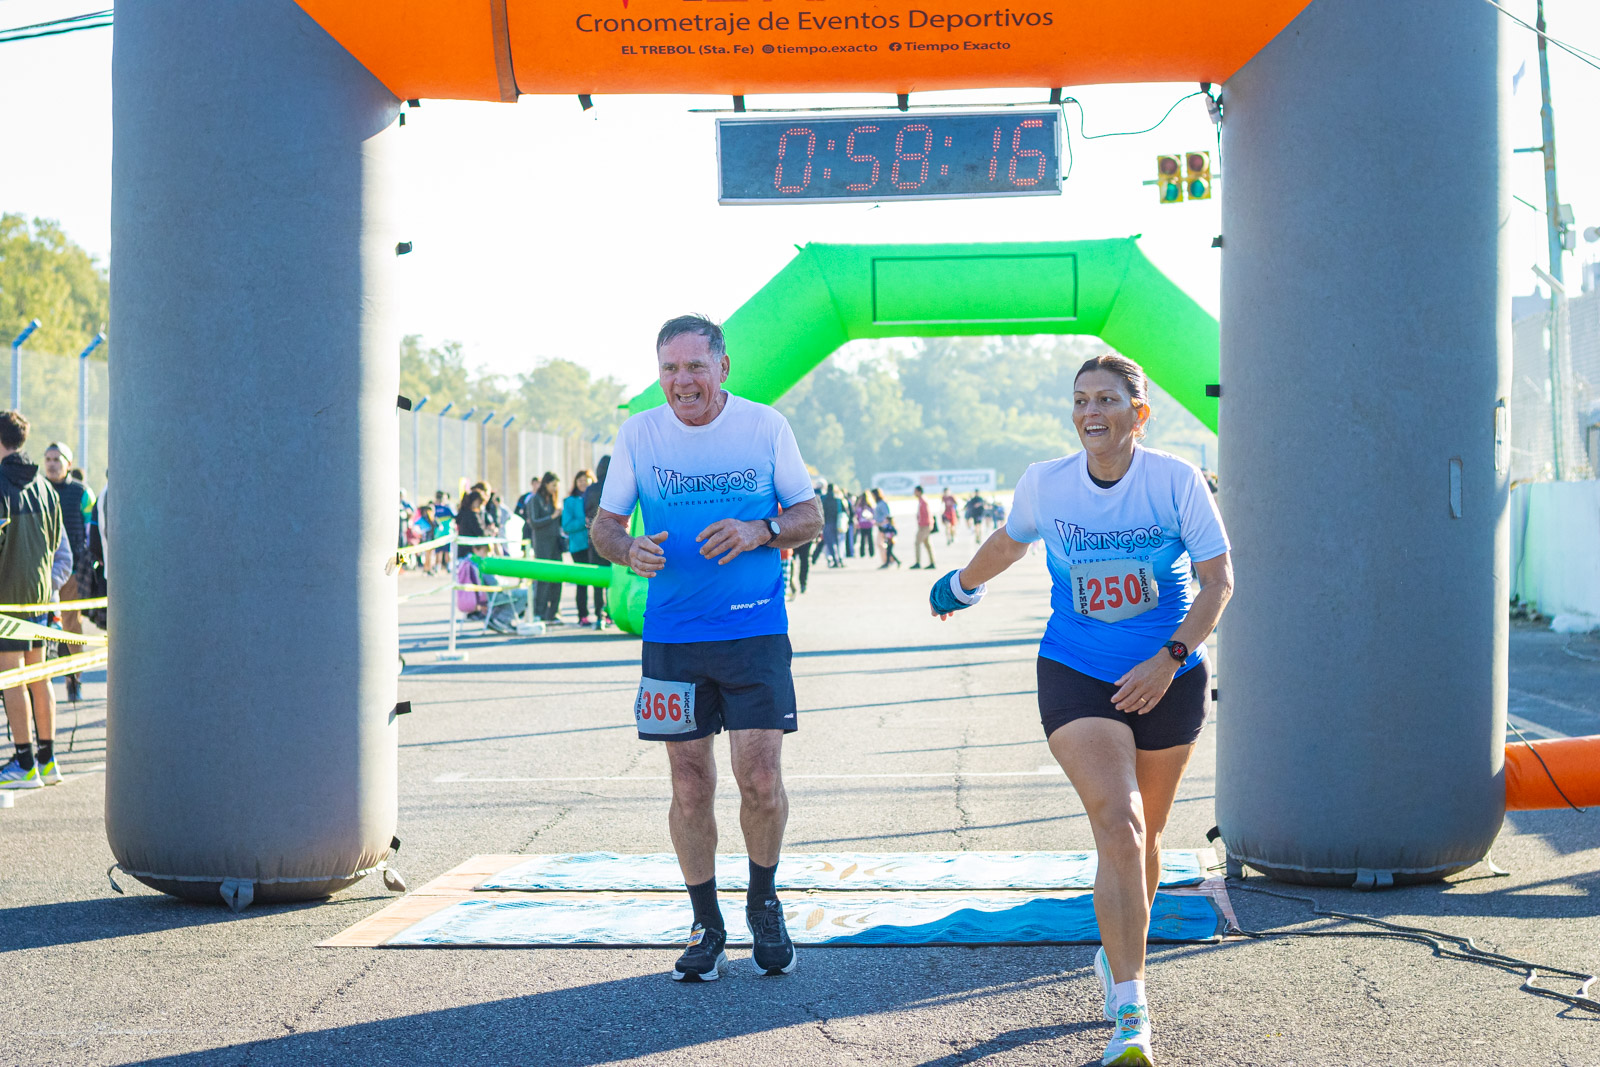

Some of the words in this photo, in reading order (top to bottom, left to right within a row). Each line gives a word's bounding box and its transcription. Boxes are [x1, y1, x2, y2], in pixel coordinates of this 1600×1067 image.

[576, 13, 751, 36] Cronometraje
[758, 11, 790, 31] de
[798, 11, 900, 31] Eventos
[909, 8, 1054, 32] Deportivos
[621, 45, 638, 55] EL
[640, 45, 696, 55] TREBOL
[699, 44, 731, 56] (Sta.
[733, 44, 755, 55] Fe)
[904, 41, 960, 53] Tiempo
[963, 40, 1011, 52] Exacto
[667, 496, 743, 507] ENTRENAMIENTO
[1076, 576, 1089, 615] TIEMPO
[1086, 573, 1143, 612] 250
[1138, 567, 1151, 603] EXACTO
[641, 690, 683, 722] 366
[683, 691, 692, 724] EXACTO
